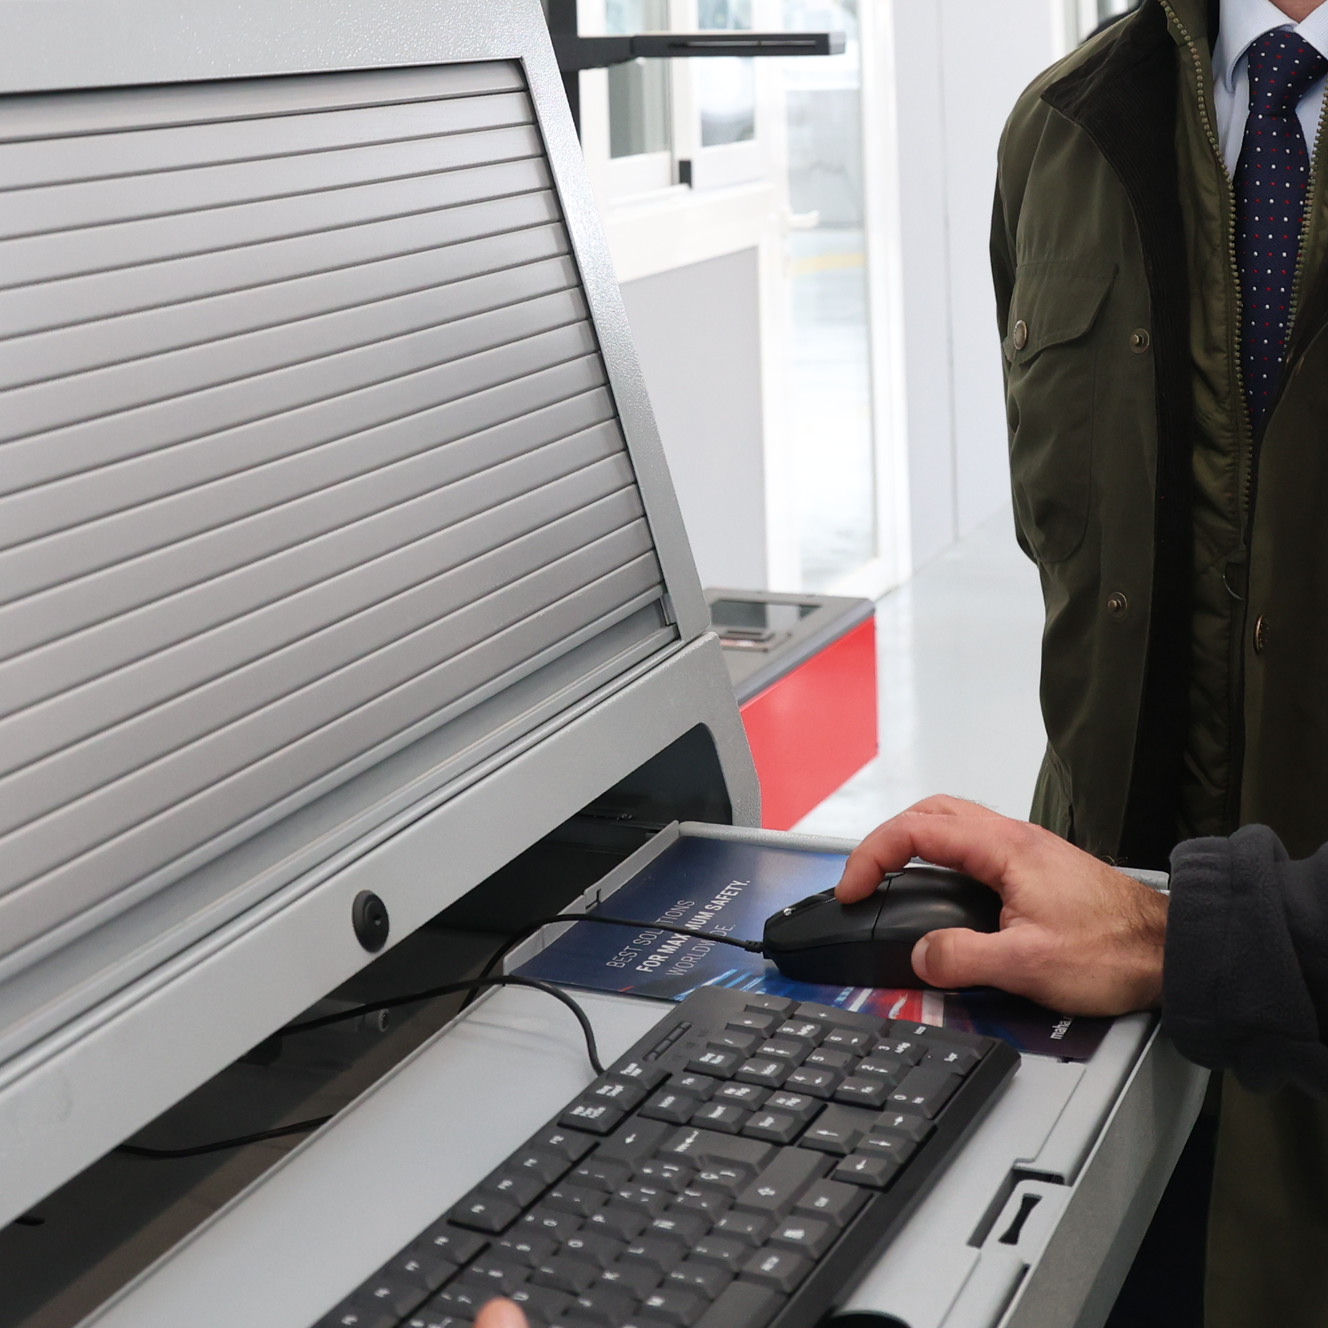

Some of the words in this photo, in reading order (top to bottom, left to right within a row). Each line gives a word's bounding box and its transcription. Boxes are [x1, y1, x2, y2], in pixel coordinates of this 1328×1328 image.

[606, 946, 643, 968] BEST
[633, 900, 695, 946] SOLTIONS
[636, 954, 669, 972] FOR
[657, 911, 715, 953] MAXMUM
[704, 879, 751, 911] SAFETY.
[665, 924, 736, 976] WORLDWDE.
